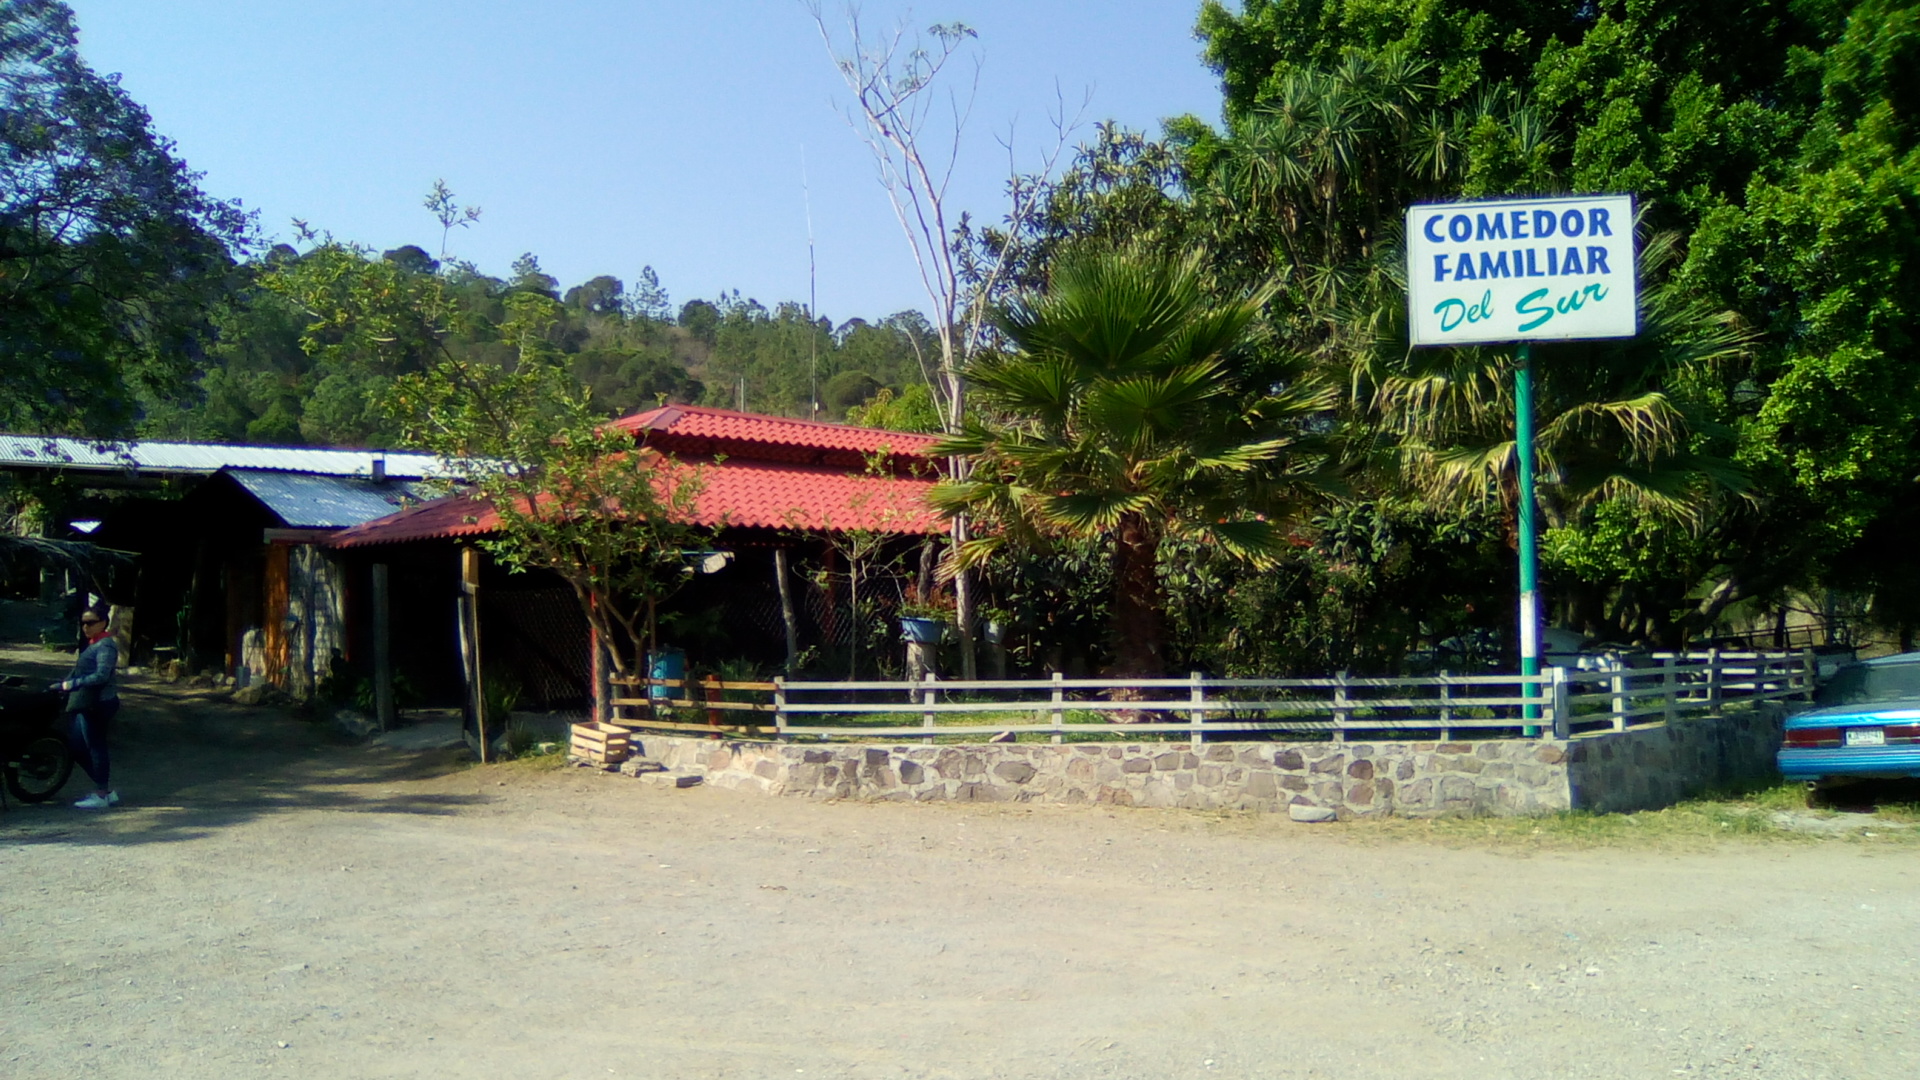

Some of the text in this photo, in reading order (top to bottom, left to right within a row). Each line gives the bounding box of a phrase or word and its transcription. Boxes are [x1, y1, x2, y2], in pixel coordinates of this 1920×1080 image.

[1424, 208, 1613, 243] COMEDOR
[1433, 245, 1611, 282] FAMILIAR
[1433, 282, 1609, 332] Del Sur
